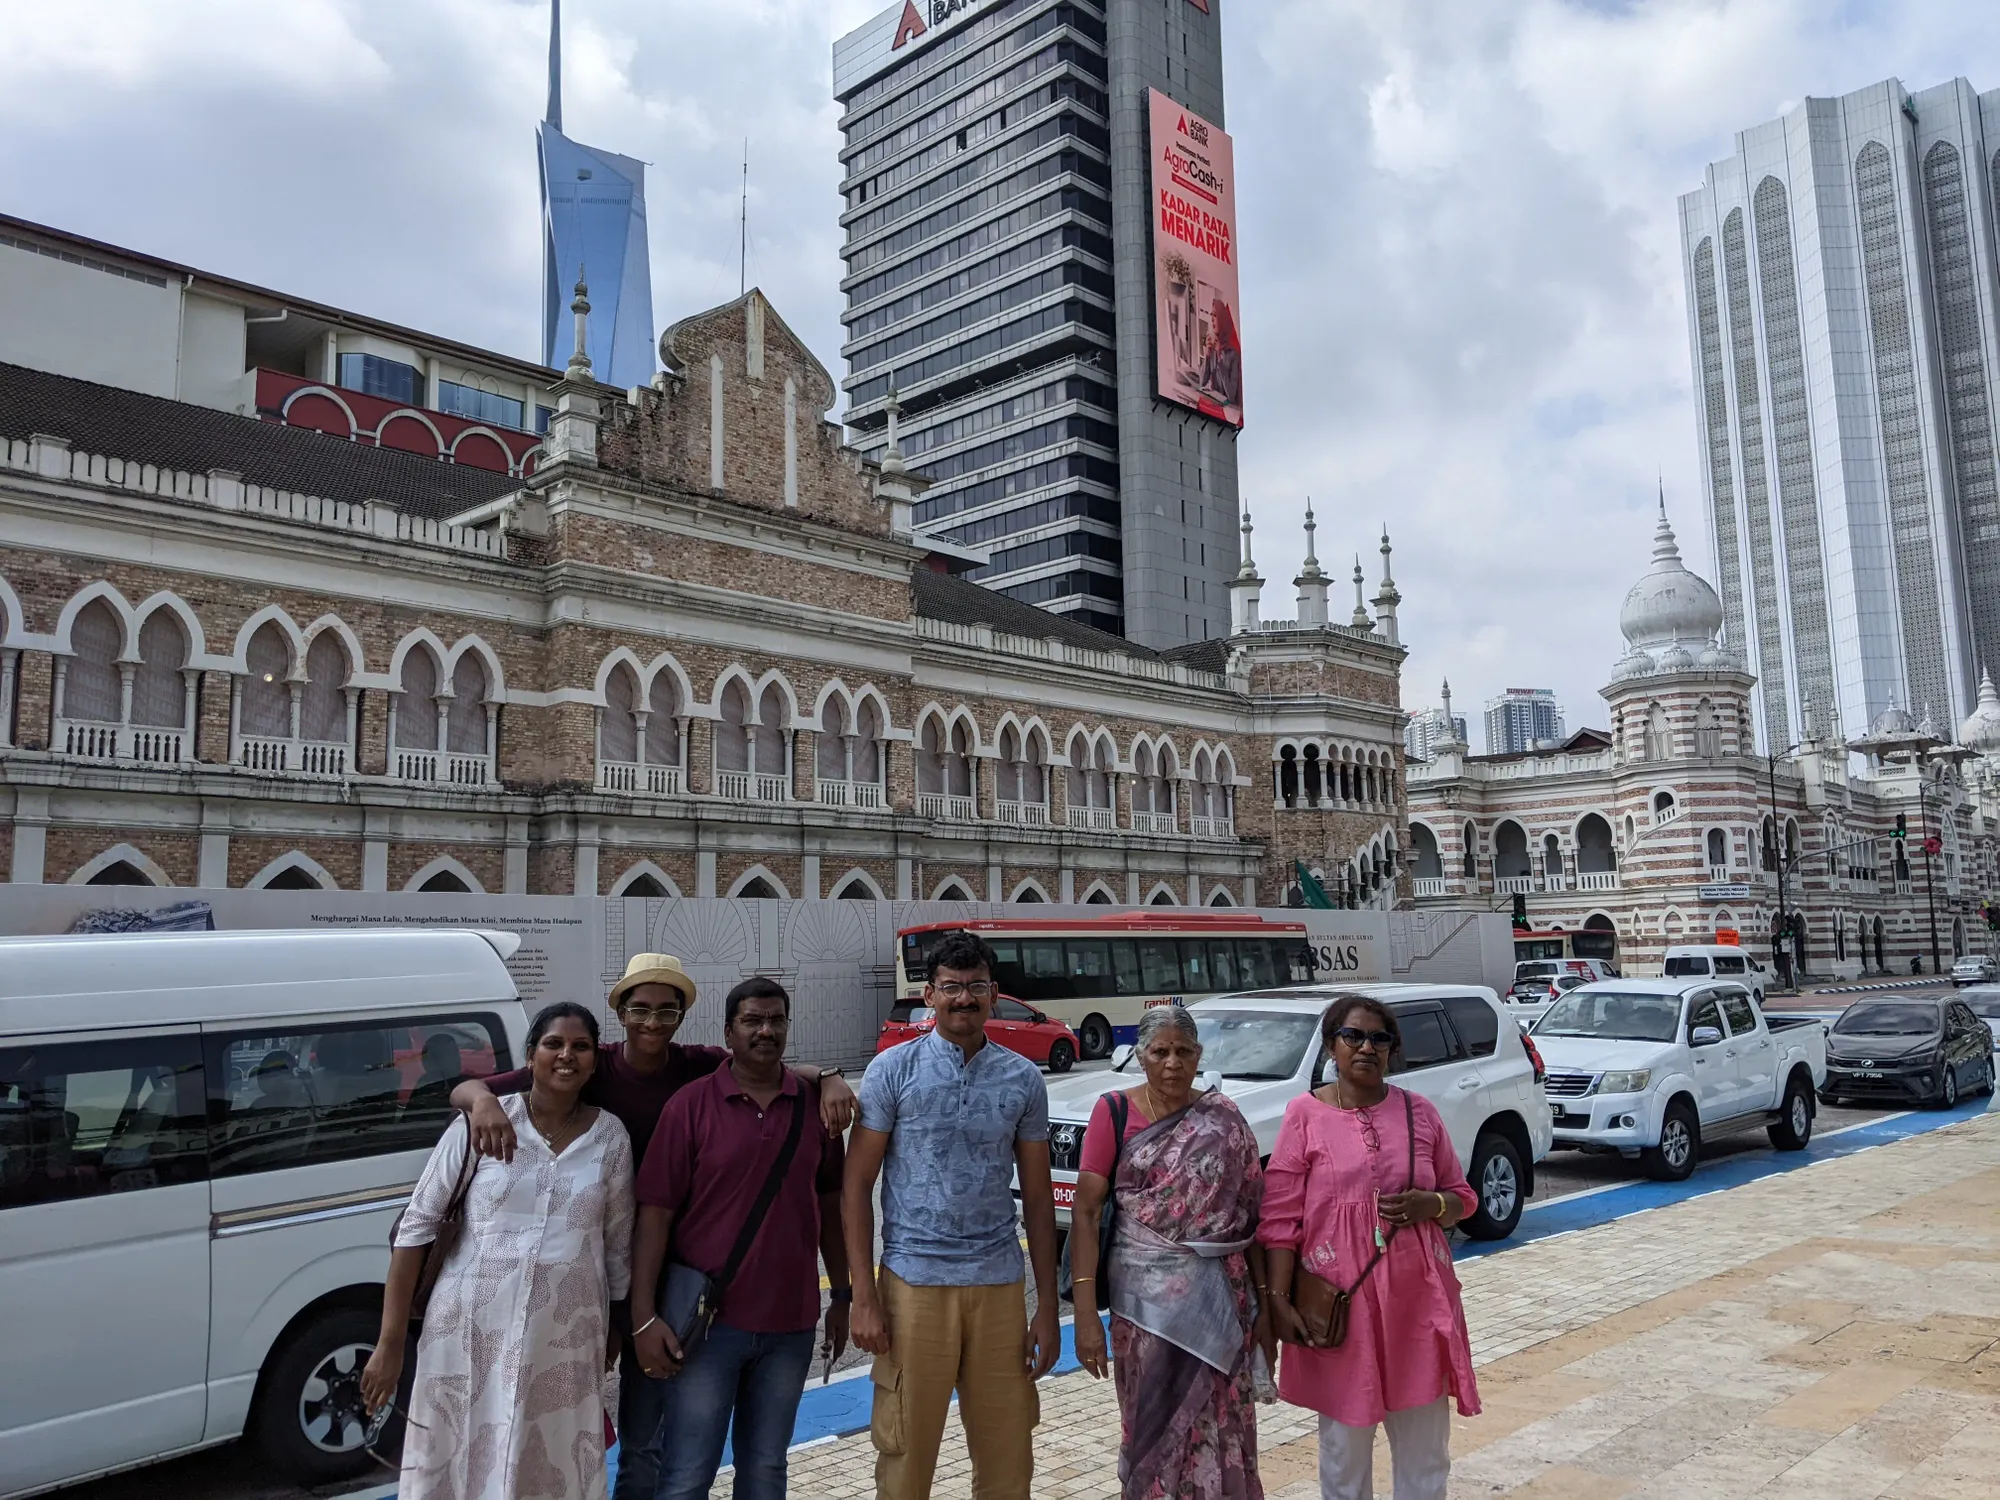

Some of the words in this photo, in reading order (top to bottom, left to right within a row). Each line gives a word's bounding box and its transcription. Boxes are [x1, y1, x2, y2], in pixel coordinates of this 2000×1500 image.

[1190, 120, 1208, 137] AGRO
[1190, 129, 1208, 148] BANK
[1164, 146, 1223, 193] AgroCash-i
[1161, 188, 1200, 224] KADAR
[1203, 211, 1230, 241] RATA
[1162, 207, 1231, 265] MENARIK
[311, 915, 358, 923] Menghargai
[1144, 997, 1185, 1009] rapidKL
